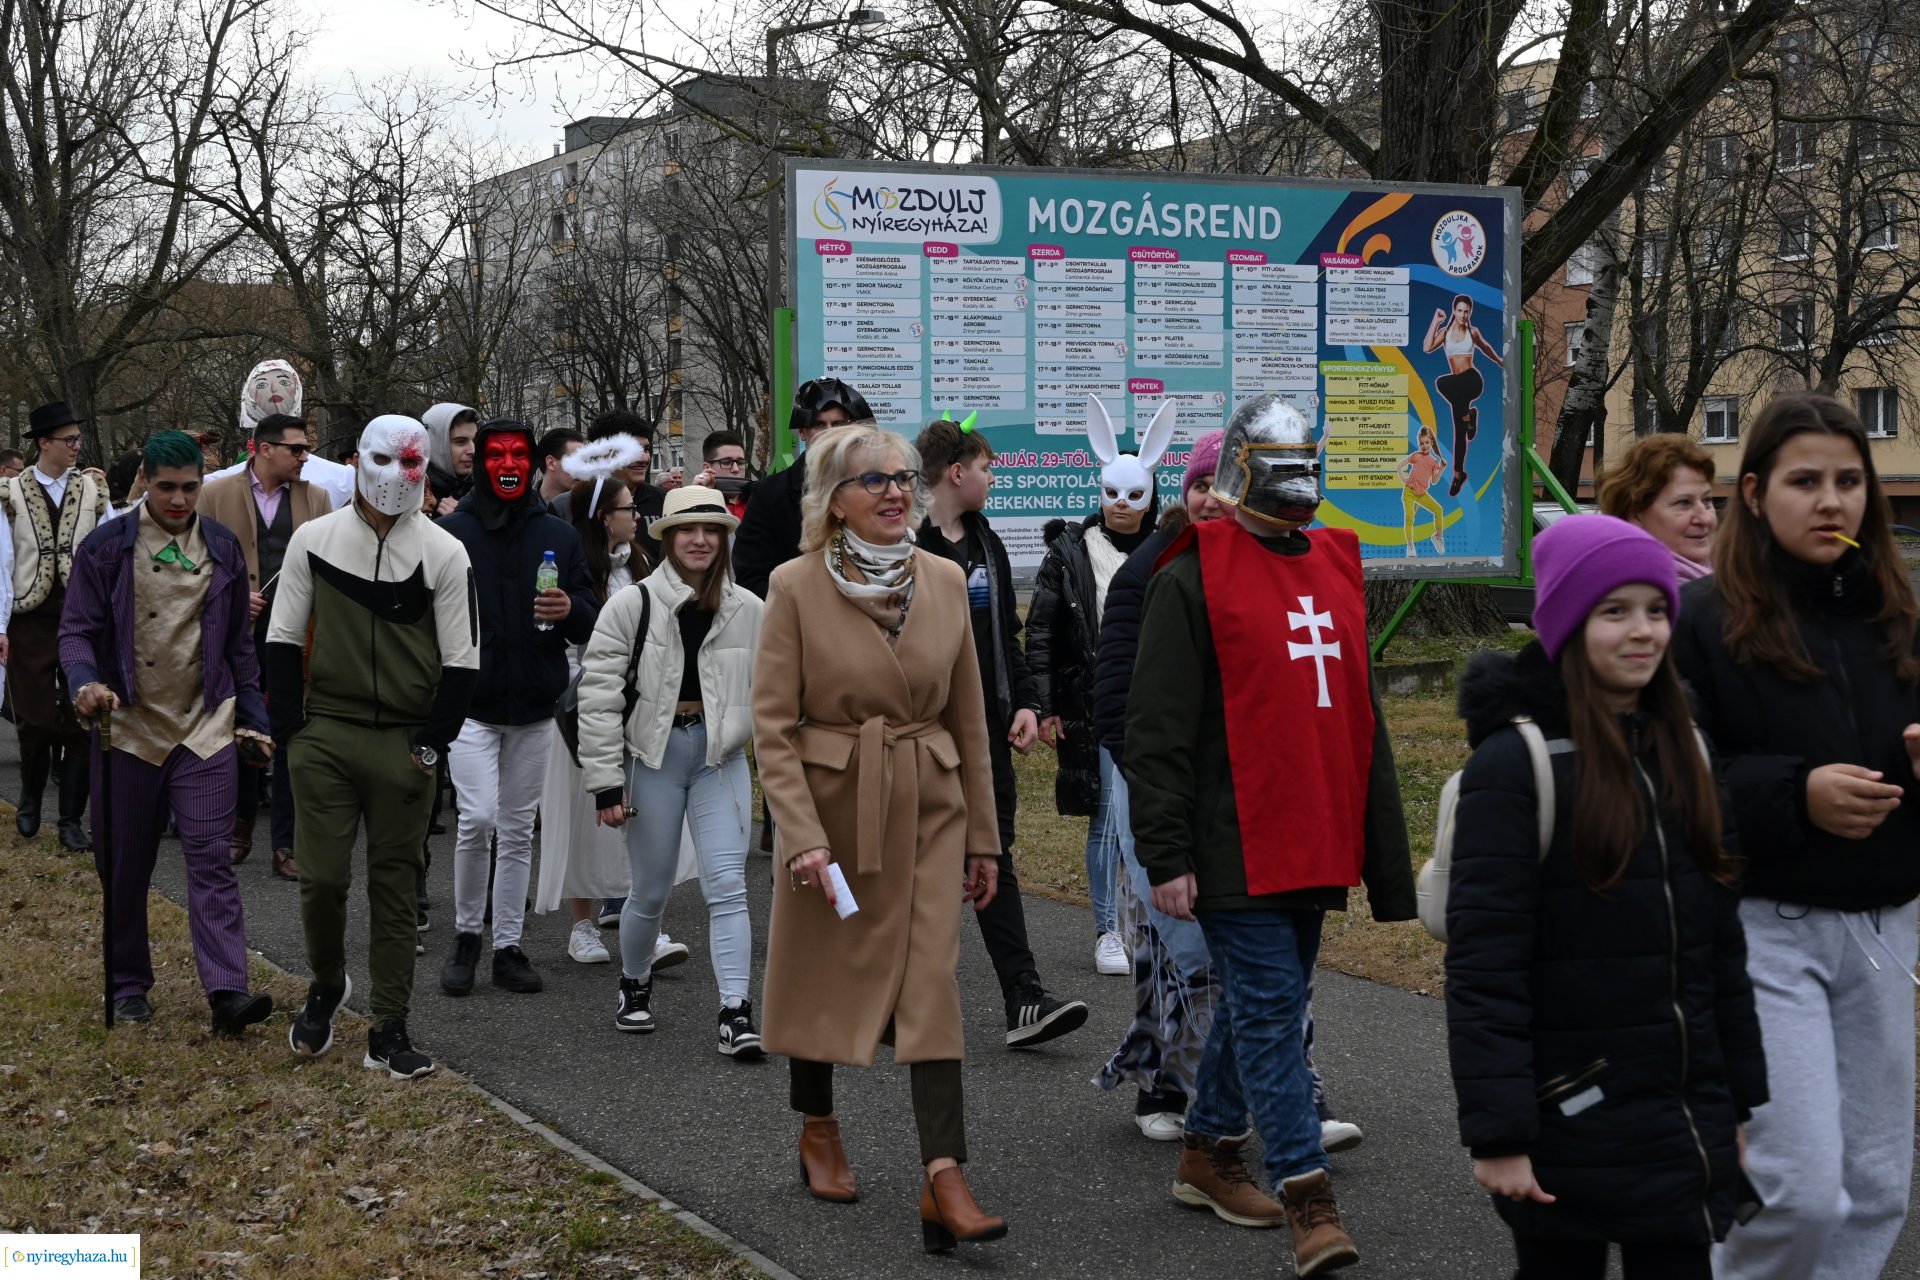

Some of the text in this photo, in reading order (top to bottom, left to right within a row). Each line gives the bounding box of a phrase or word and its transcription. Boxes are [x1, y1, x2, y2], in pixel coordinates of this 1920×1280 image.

[852, 211, 988, 235] NYÍREGYHÁZA!
[1029, 192, 1282, 240] MOZGÁSREND
[1435, 214, 1468, 240] MOZDULJKA
[1132, 250, 1175, 259] CSÜTÖRTÖK
[1449, 245, 1483, 273] PROGRAMOK
[1323, 364, 1395, 372] SPORTRENDEZVÉNYEK
[1041, 449, 1093, 467] 29-TŐL
[1067, 492, 1084, 508] ÉS
